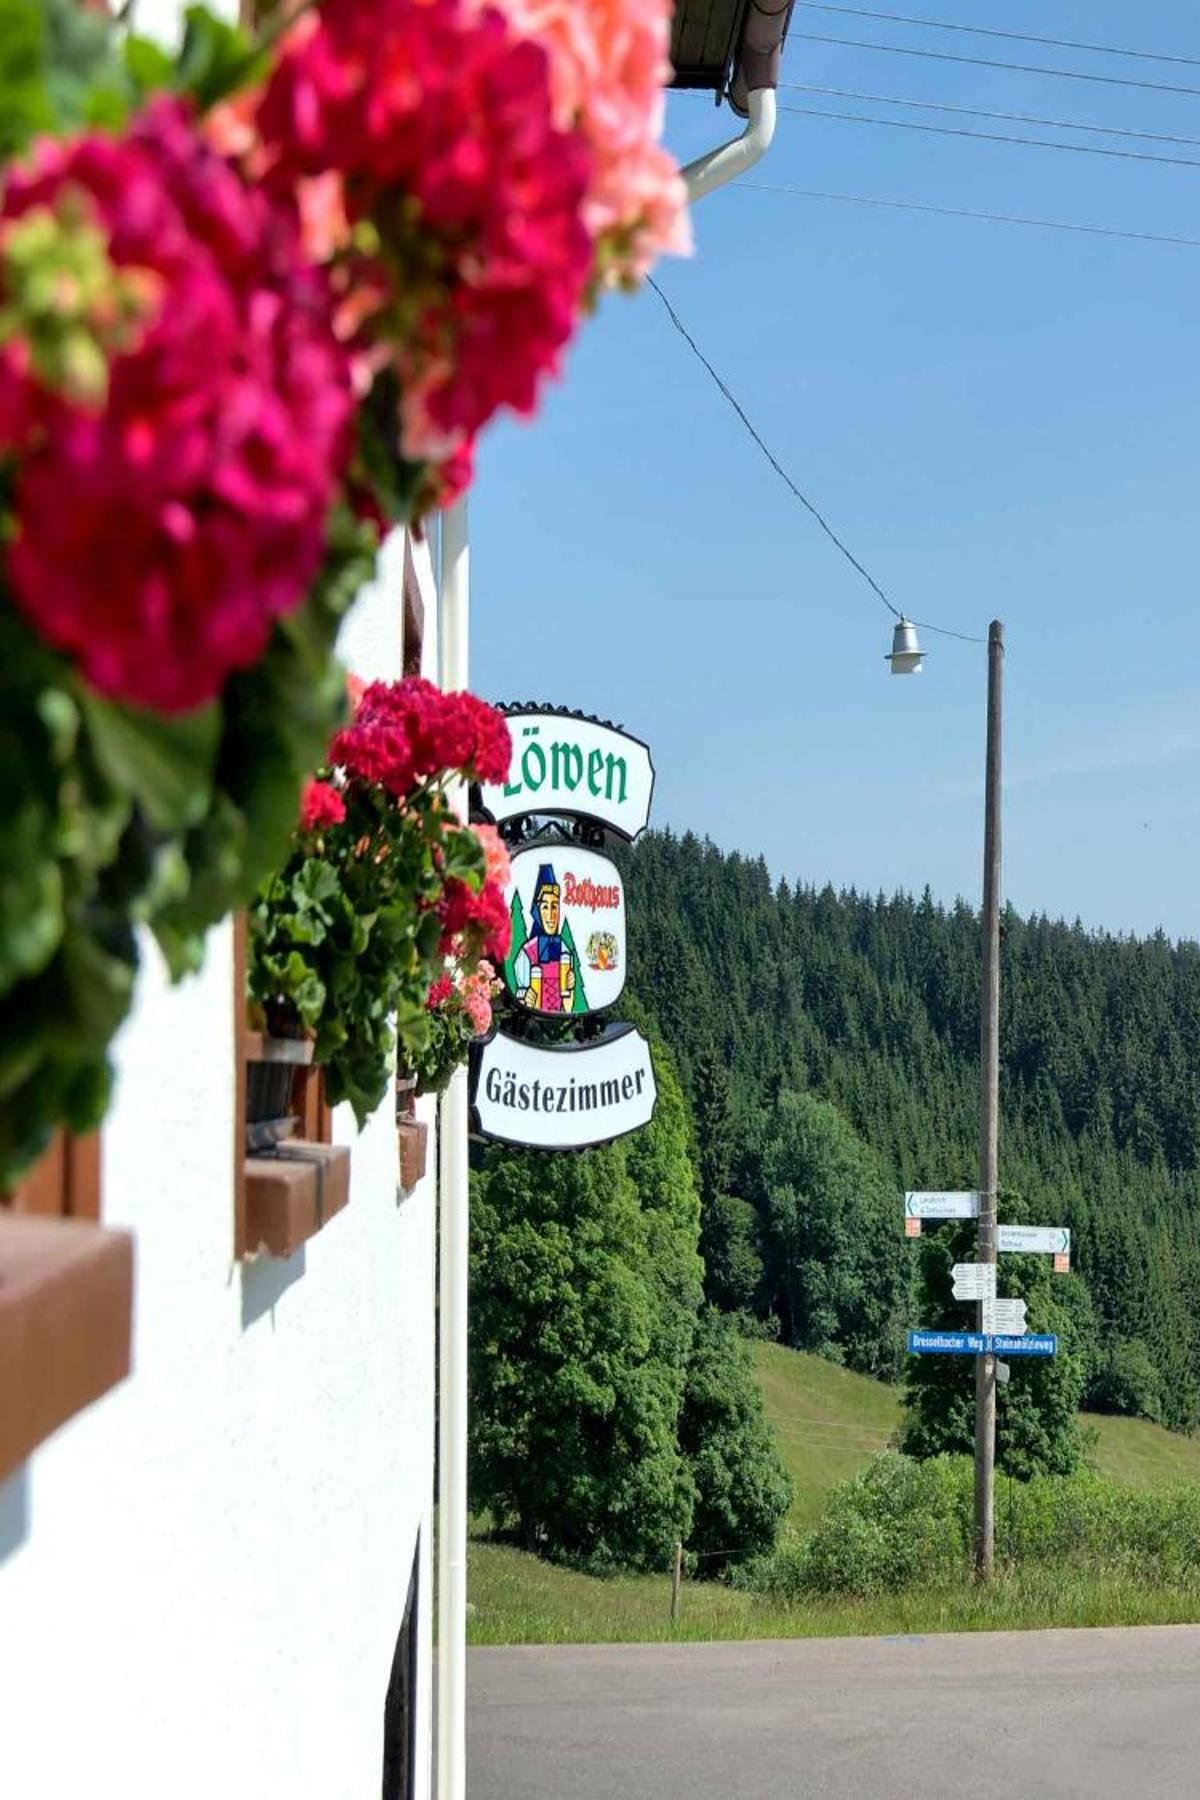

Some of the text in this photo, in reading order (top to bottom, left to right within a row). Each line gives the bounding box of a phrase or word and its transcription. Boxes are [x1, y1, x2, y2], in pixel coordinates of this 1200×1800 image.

[563, 871, 621, 913] Rothaus
[485, 1066, 646, 1113] Gästezimmer
[967, 1336, 984, 1352] Weg
